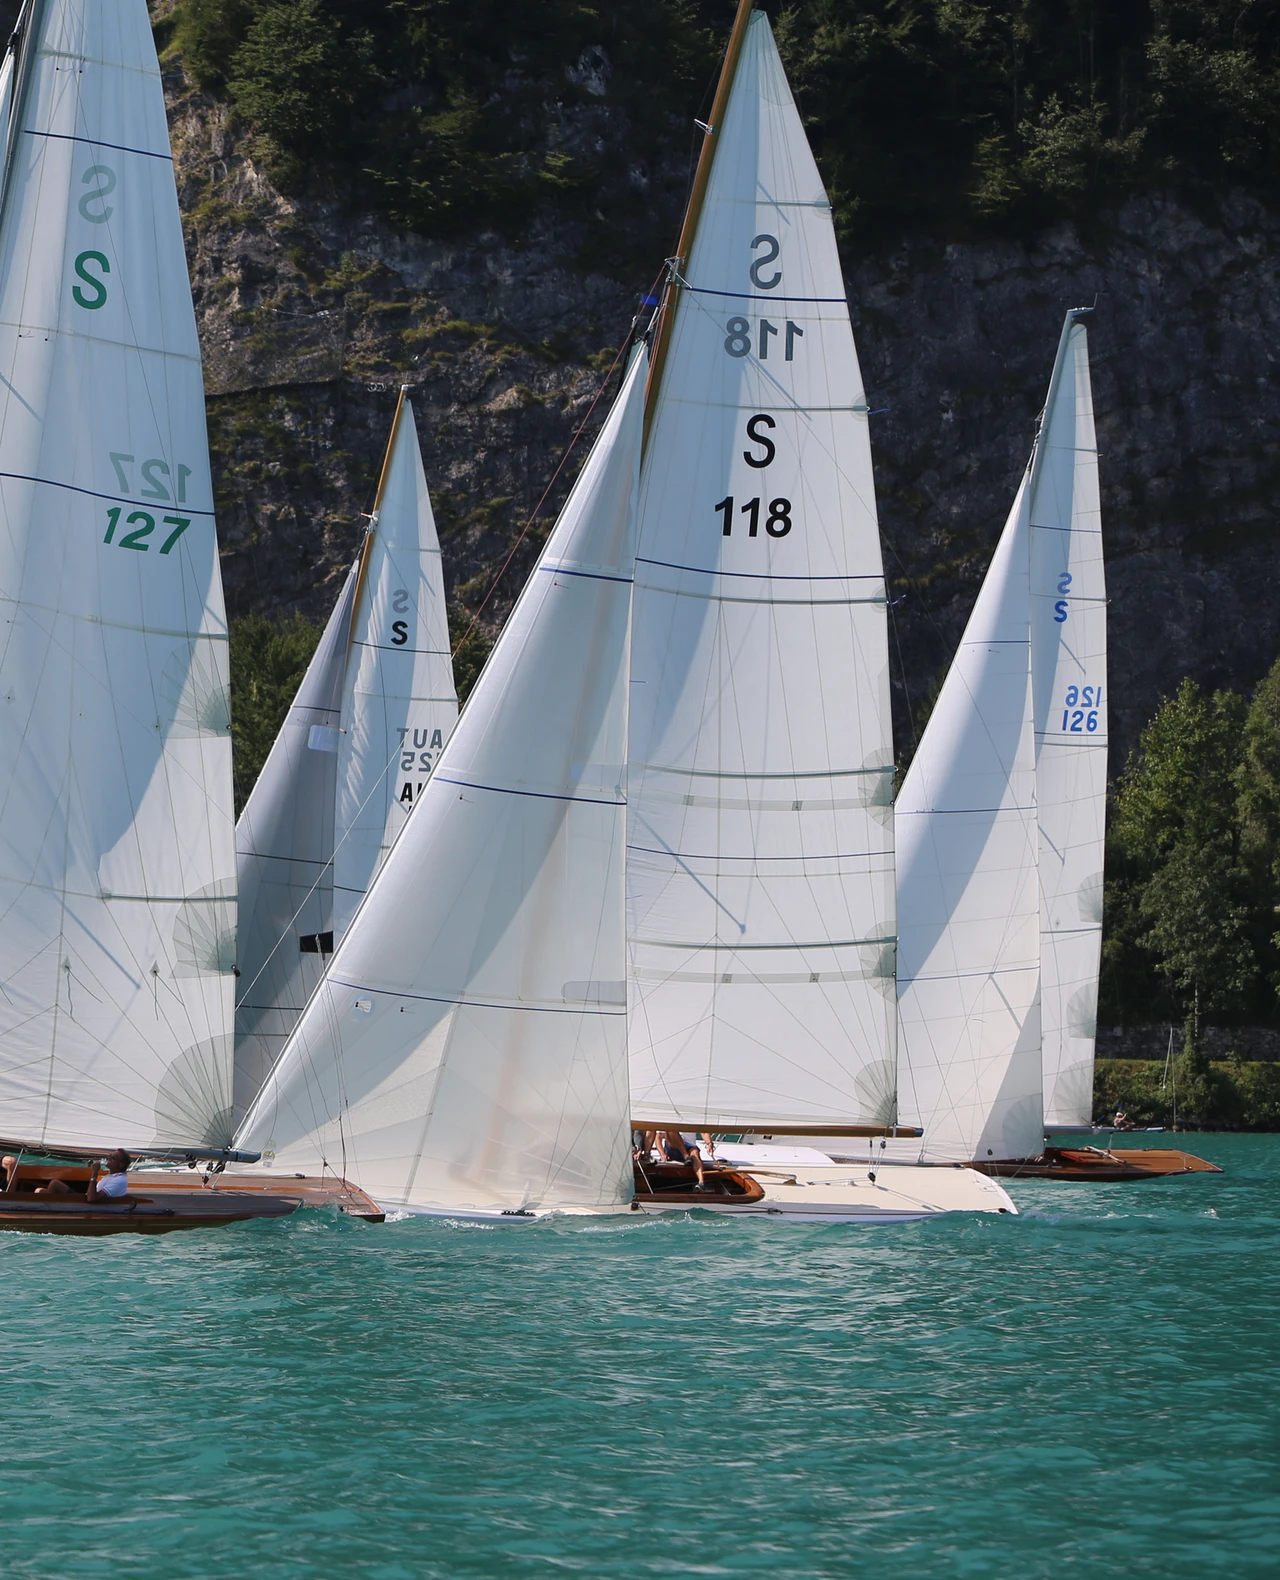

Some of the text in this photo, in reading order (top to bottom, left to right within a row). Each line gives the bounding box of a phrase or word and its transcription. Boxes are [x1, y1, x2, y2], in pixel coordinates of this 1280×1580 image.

[72, 250, 111, 309] S
[743, 414, 776, 468] S
[103, 507, 191, 555] 127
[714, 496, 792, 538] 118
[391, 620, 408, 645] S
[1053, 600, 1069, 623] S
[1062, 710, 1098, 732] 126
